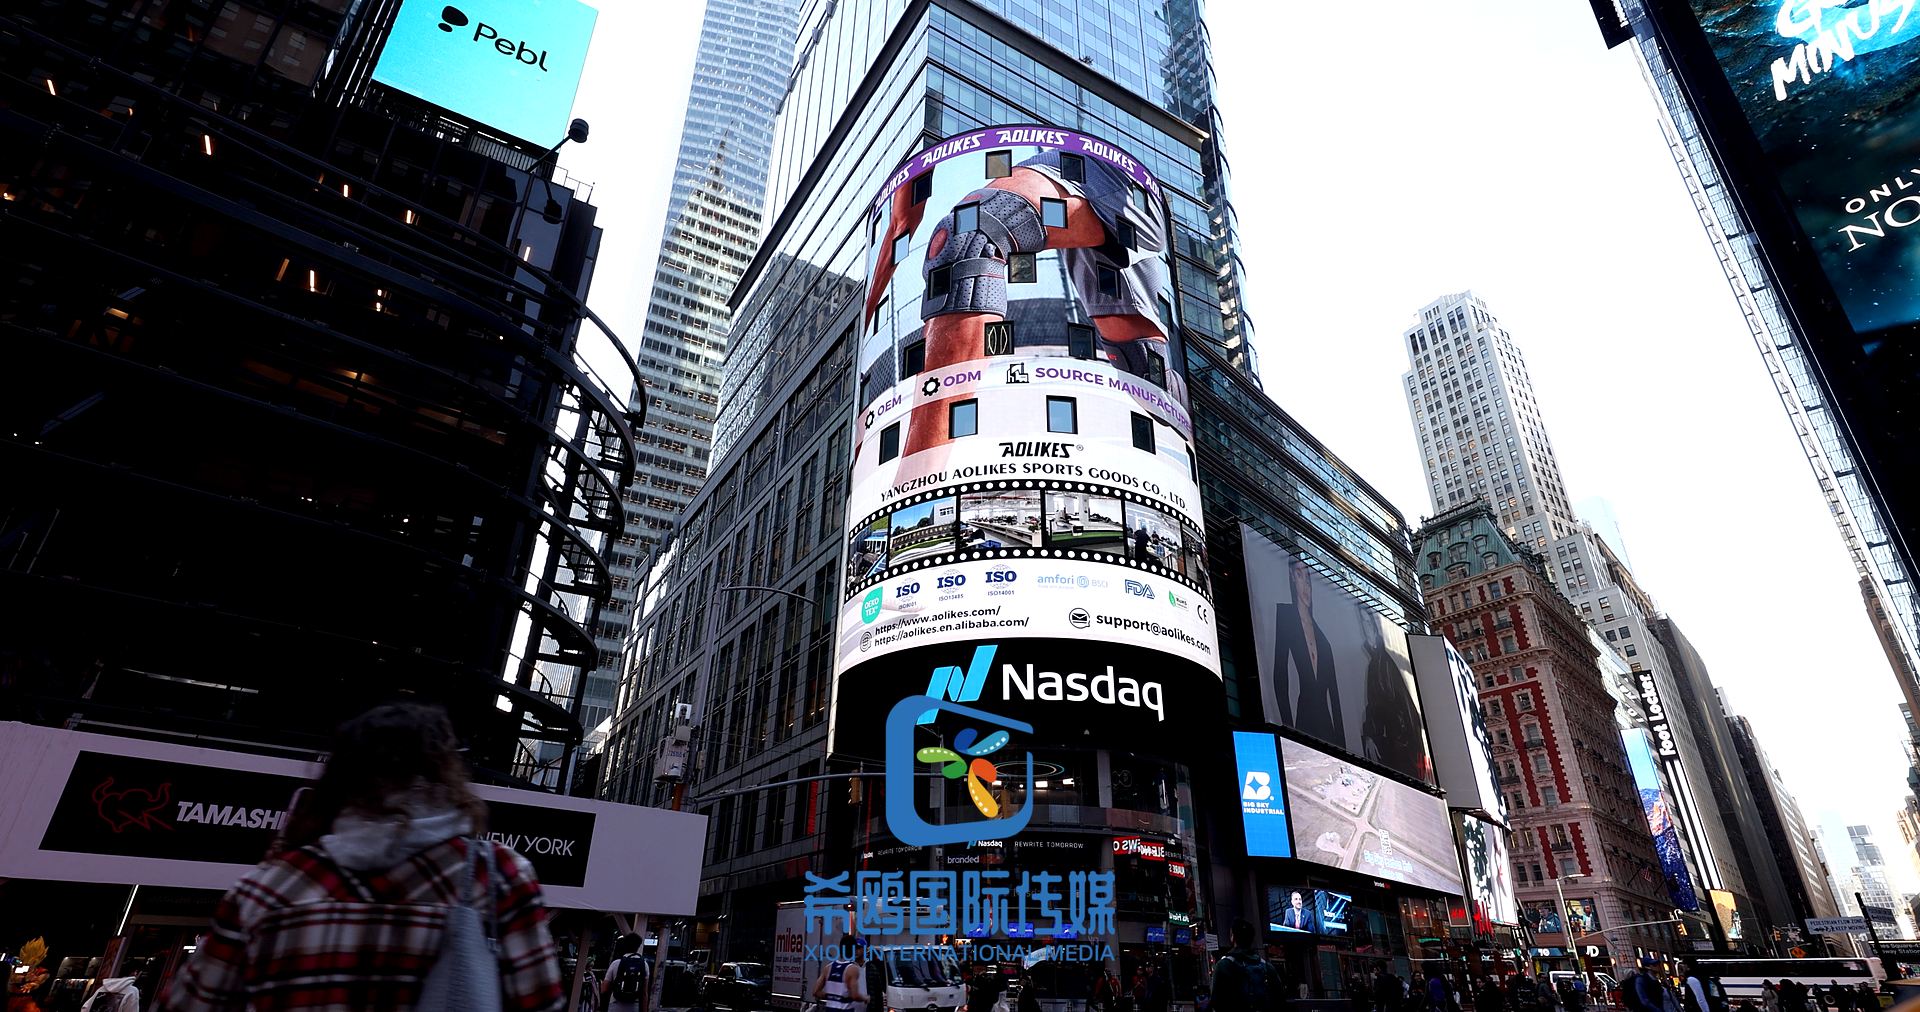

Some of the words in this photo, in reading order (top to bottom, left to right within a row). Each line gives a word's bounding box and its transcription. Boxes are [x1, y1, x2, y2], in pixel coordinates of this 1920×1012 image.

[473, 22, 548, 72] Pebl
[920, 133, 985, 168] AOLIKES
[996, 129, 1069, 145] AOLIKES
[1079, 137, 1137, 173] AOLIKES
[943, 370, 982, 387] ODM
[1035, 367, 1104, 386] SOURCE
[877, 394, 902, 417] OEM
[999, 441, 1075, 459] AOLIKES
[880, 471, 948, 502] YANGZHOU
[952, 463, 1017, 480] AOLIKES
[1022, 462, 1083, 477] SPORTS
[1088, 467, 1139, 488] GOODS
[1169, 491, 1188, 512] LTD.
[936, 574, 966, 589] ISO
[985, 570, 1018, 584] ISO
[1037, 573, 1074, 585] amfori
[896, 582, 921, 598] ISO
[1124, 578, 1156, 600] FDA
[874, 605, 1002, 635] https://www.aolikes.com/
[874, 617, 1030, 647] https://aolikes.en.alibaba.com/
[1096, 614, 1211, 656] support@aolikes.com
[1002, 663, 1164, 721] Nasdaq
[1639, 673, 1665, 722] Locker
[1653, 723, 1677, 756] Foot
[1243, 807, 1285, 816] INDUSTRIAL
[523, 835, 576, 857] YORK
[978, 839, 1003, 848] Nasdaq
[1046, 841, 1084, 849] TOMORROW
[947, 855, 980, 864] branded
[775, 927, 803, 952] milea
